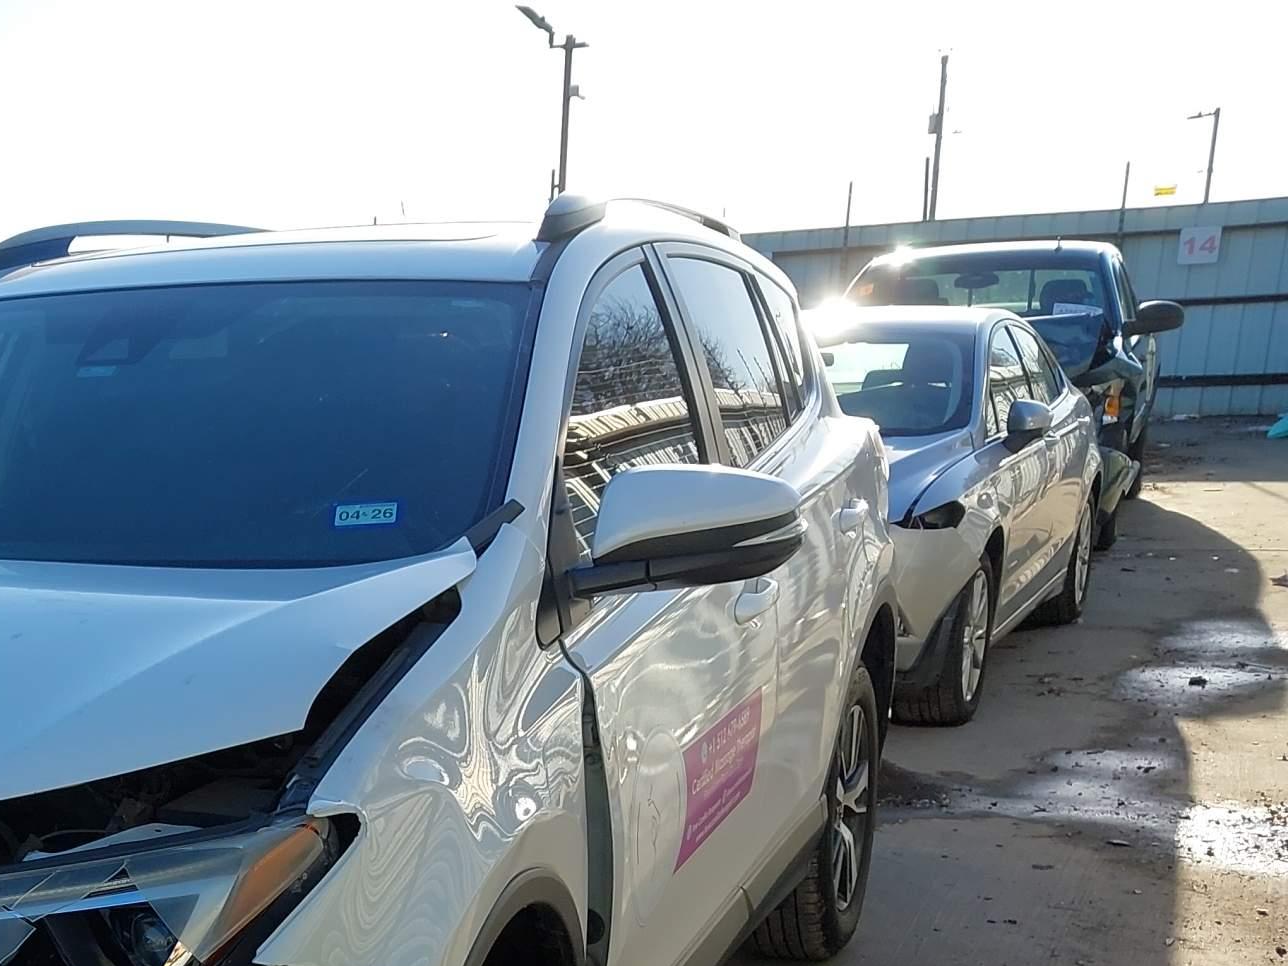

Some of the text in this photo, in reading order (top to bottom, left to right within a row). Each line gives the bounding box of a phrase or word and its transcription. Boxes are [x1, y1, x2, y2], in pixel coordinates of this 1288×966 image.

[1184, 236, 1217, 256] 14
[339, 508, 393, 521] 04 26
